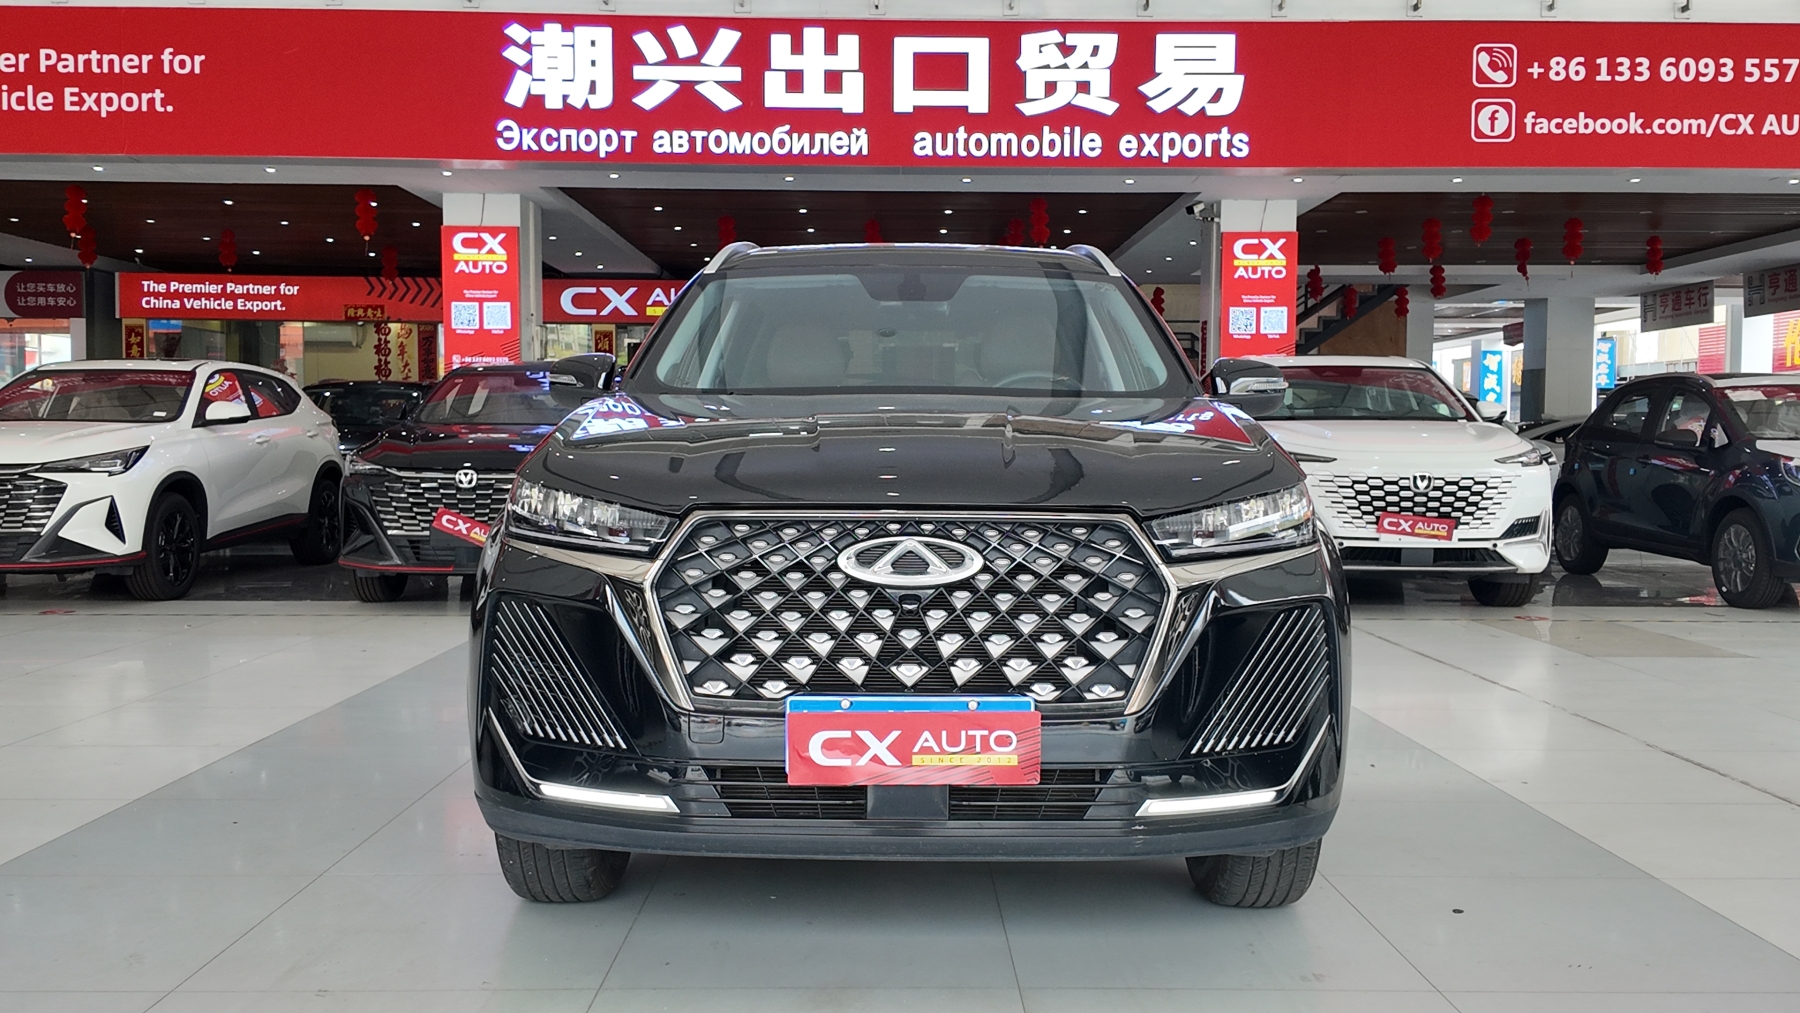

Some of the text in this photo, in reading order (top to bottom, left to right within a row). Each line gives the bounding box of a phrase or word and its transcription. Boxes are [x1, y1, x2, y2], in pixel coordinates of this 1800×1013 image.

[0, 47, 205, 74] er Partner for
[501, 21, 1246, 117] 潮兴出口贸易
[1527, 56, 1800, 83] +86 133 6093 557
[1, 84, 174, 118] icle Export.
[1523, 111, 1800, 138] facebook.com/CX AU
[495, 118, 869, 159] Экспорт автомобилей
[912, 125, 1251, 164] automobile exports
[452, 231, 507, 254] CX
[1232, 238, 1287, 260] CX
[454, 260, 508, 274] AUTO
[1233, 266, 1287, 279] AUTO
[16, 282, 77, 293] 让您买车放心
[141, 280, 299, 295] The Premier Partner for
[1659, 285, 1709, 314] 亨通车行
[17, 296, 77, 307] 让您用车安心
[141, 297, 286, 313] China Vehicle Export.
[560, 286, 638, 316] CX
[441, 514, 472, 535] CX
[1382, 517, 1414, 533] CX
[1415, 521, 1449, 532] AUTO
[808, 730, 1018, 767] CX AUTO
